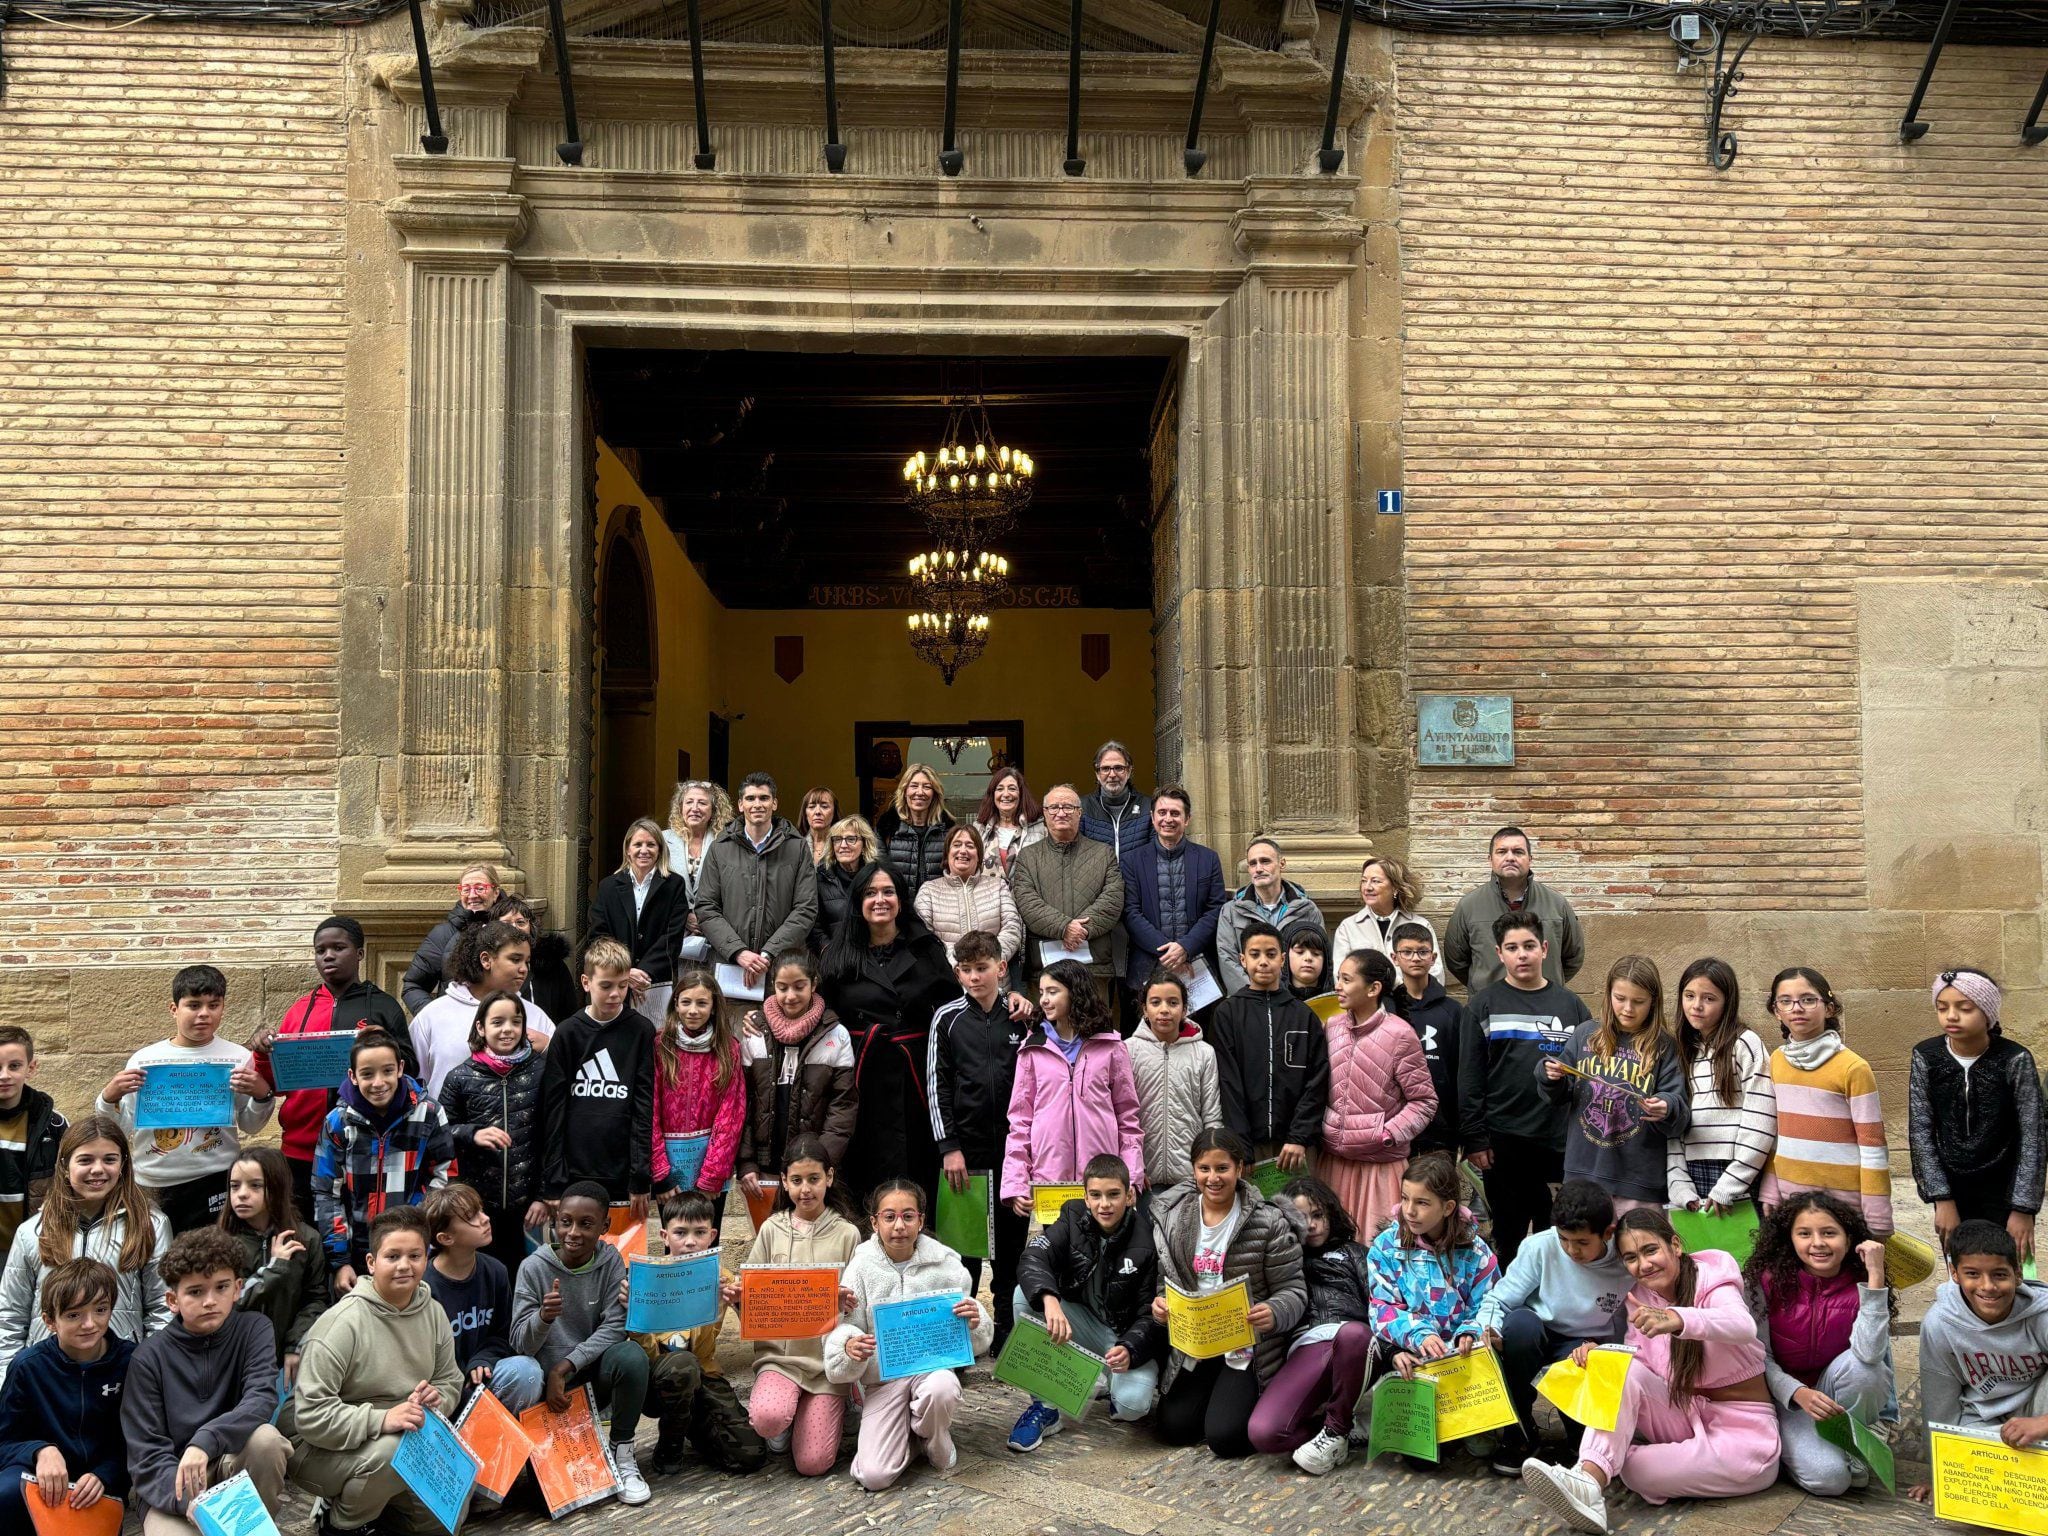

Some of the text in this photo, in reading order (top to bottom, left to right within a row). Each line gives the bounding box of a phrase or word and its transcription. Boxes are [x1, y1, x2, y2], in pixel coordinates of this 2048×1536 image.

[1384, 491, 1394, 511] 1
[1424, 728, 1510, 742] AYUNTAMIENTO
[1435, 744, 1498, 759] DE HUESCA
[1538, 1042, 1565, 1052] adid
[778, 1047, 799, 1085] A
[1577, 1055, 1655, 1094] OGWART
[450, 1306, 494, 1337] didas
[1430, 1367, 1459, 1377] RTÍCULO
[1963, 1352, 2048, 1385] ARVAR
[1971, 1450, 2009, 1462] ARTÍCULO
[1943, 1461, 1965, 1470] NADIE
[1974, 1466, 1995, 1474] DEBE
[1944, 1476, 1982, 1488] EXPLOTAR
[2004, 1486, 2023, 1496] NIÑO
[1963, 1487, 1998, 1499] EJERCER
[1944, 1492, 1970, 1502] SOBRE
